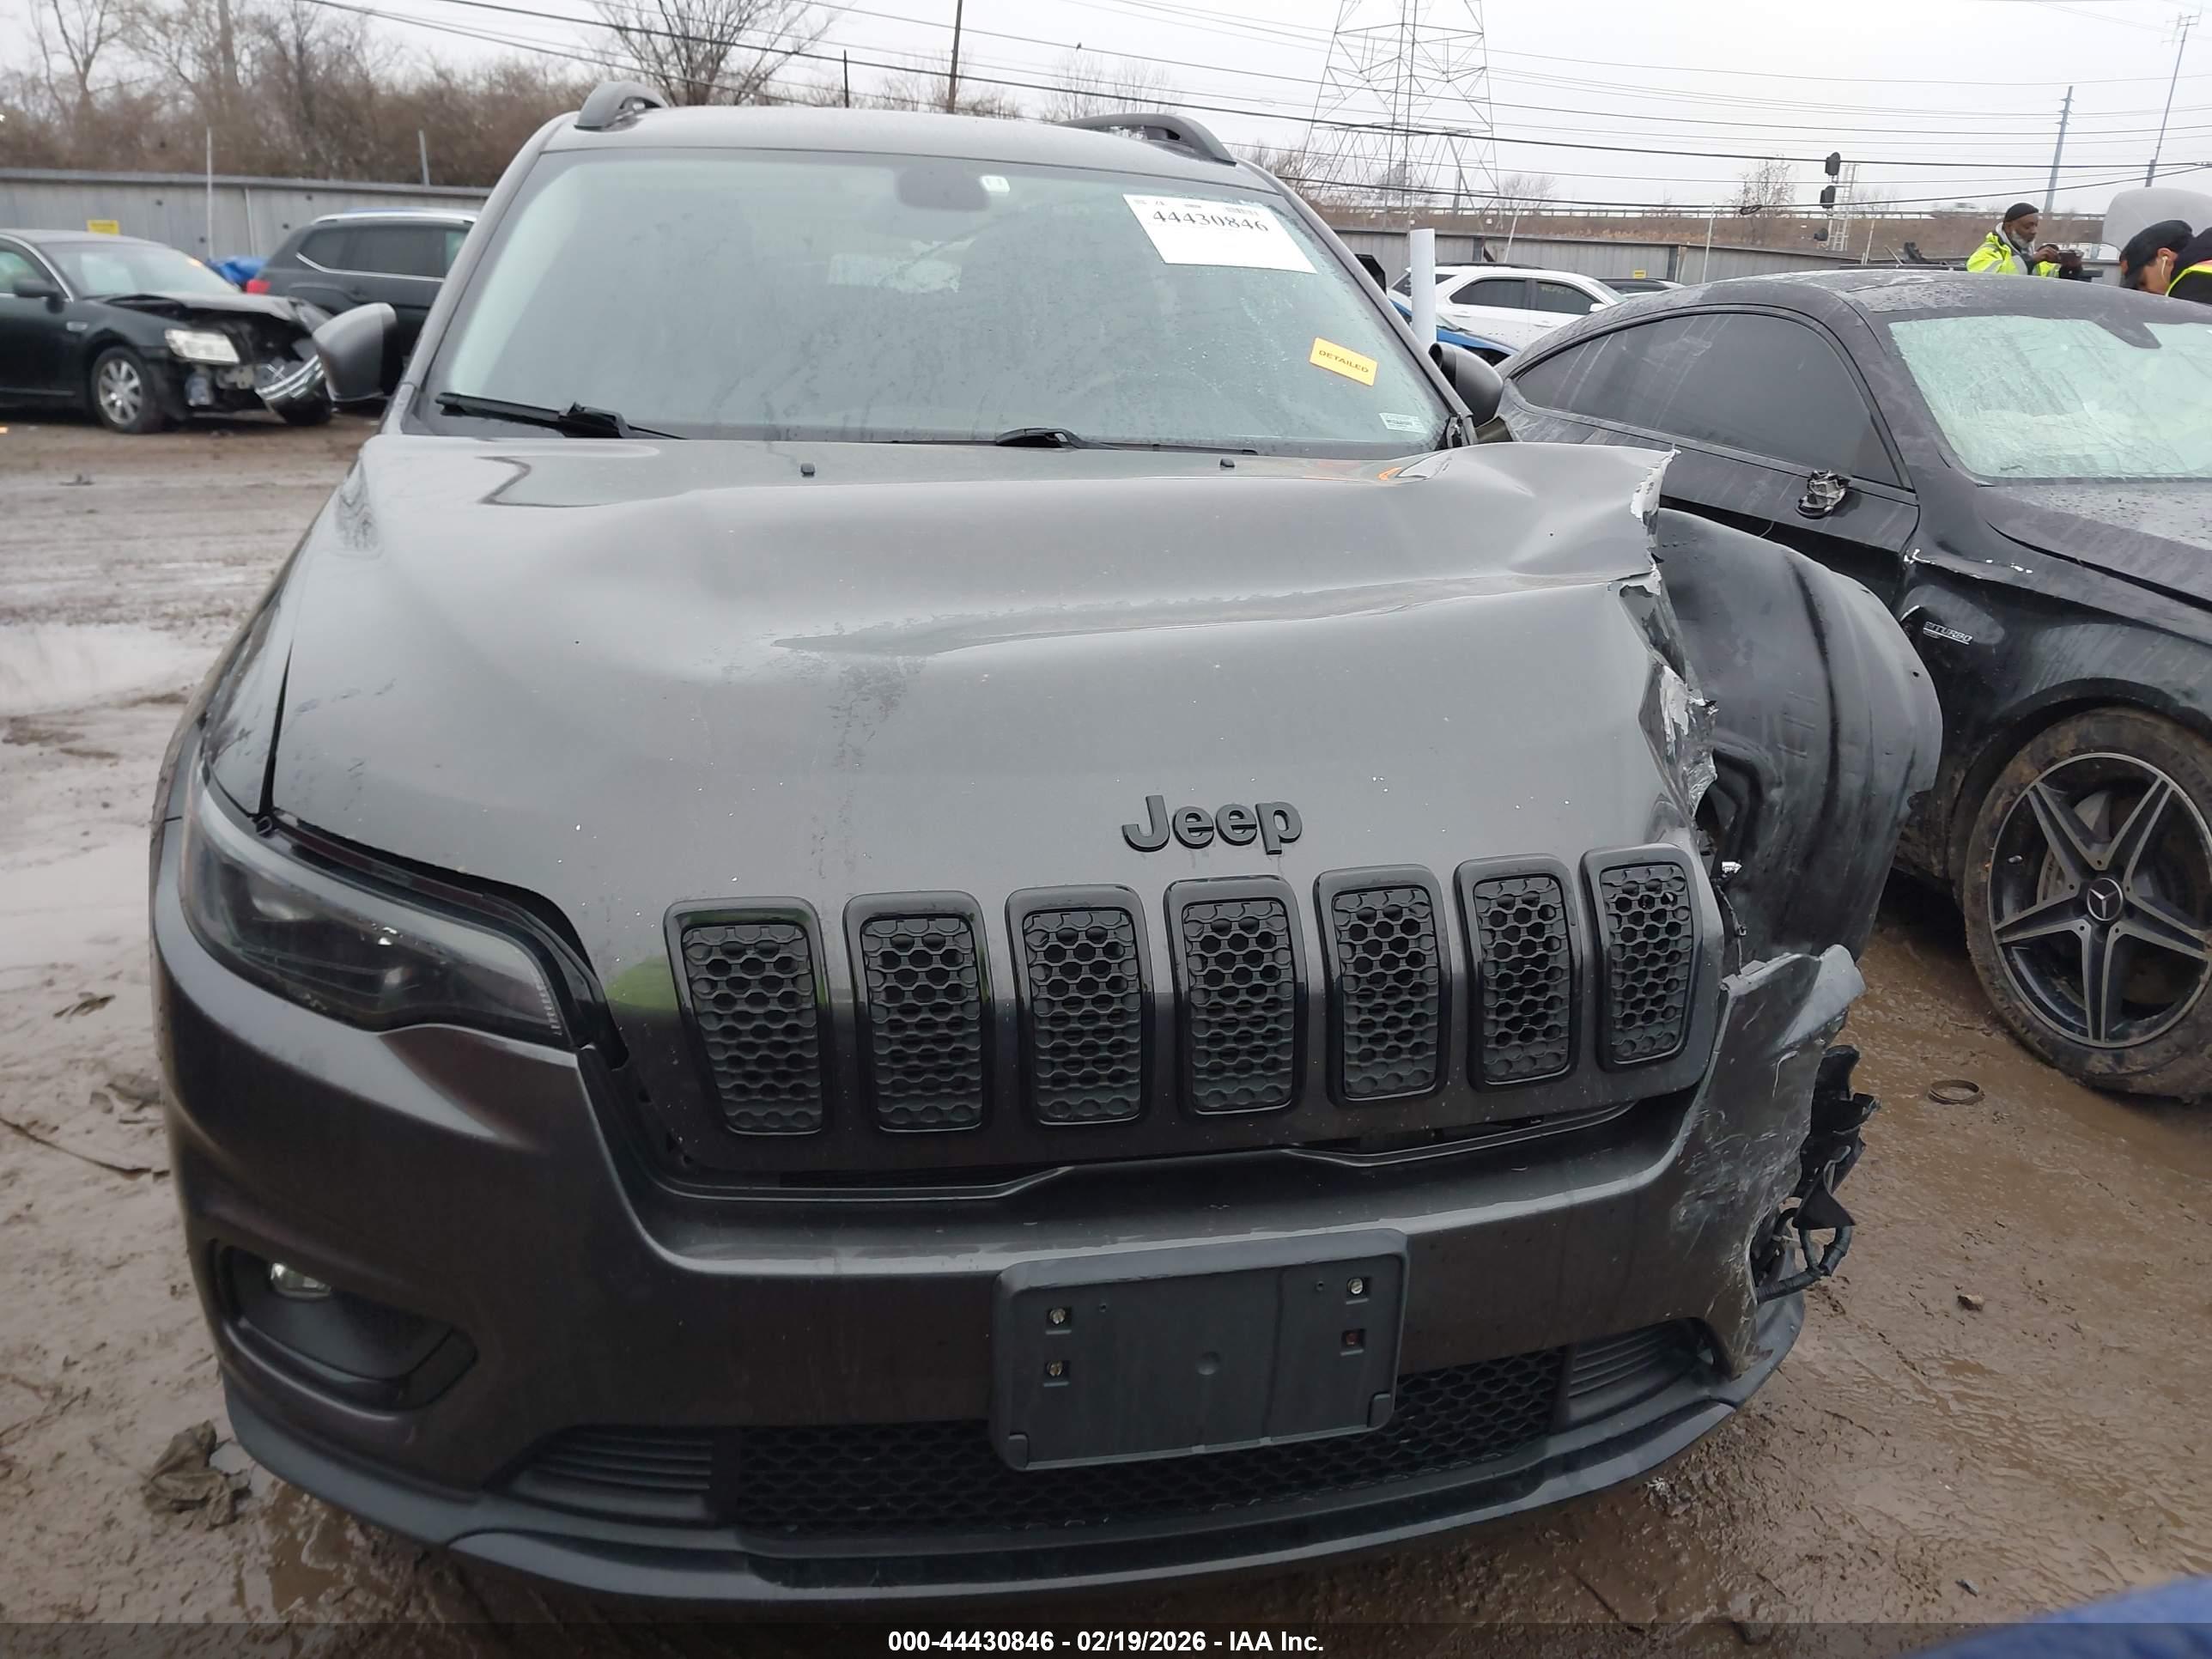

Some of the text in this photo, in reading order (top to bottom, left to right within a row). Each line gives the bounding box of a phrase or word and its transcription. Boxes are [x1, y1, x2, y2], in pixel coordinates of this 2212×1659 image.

[1153, 210, 1269, 231] 44430846
[1318, 349, 1369, 373] DETAILED
[1121, 795, 1303, 855] Jeep
